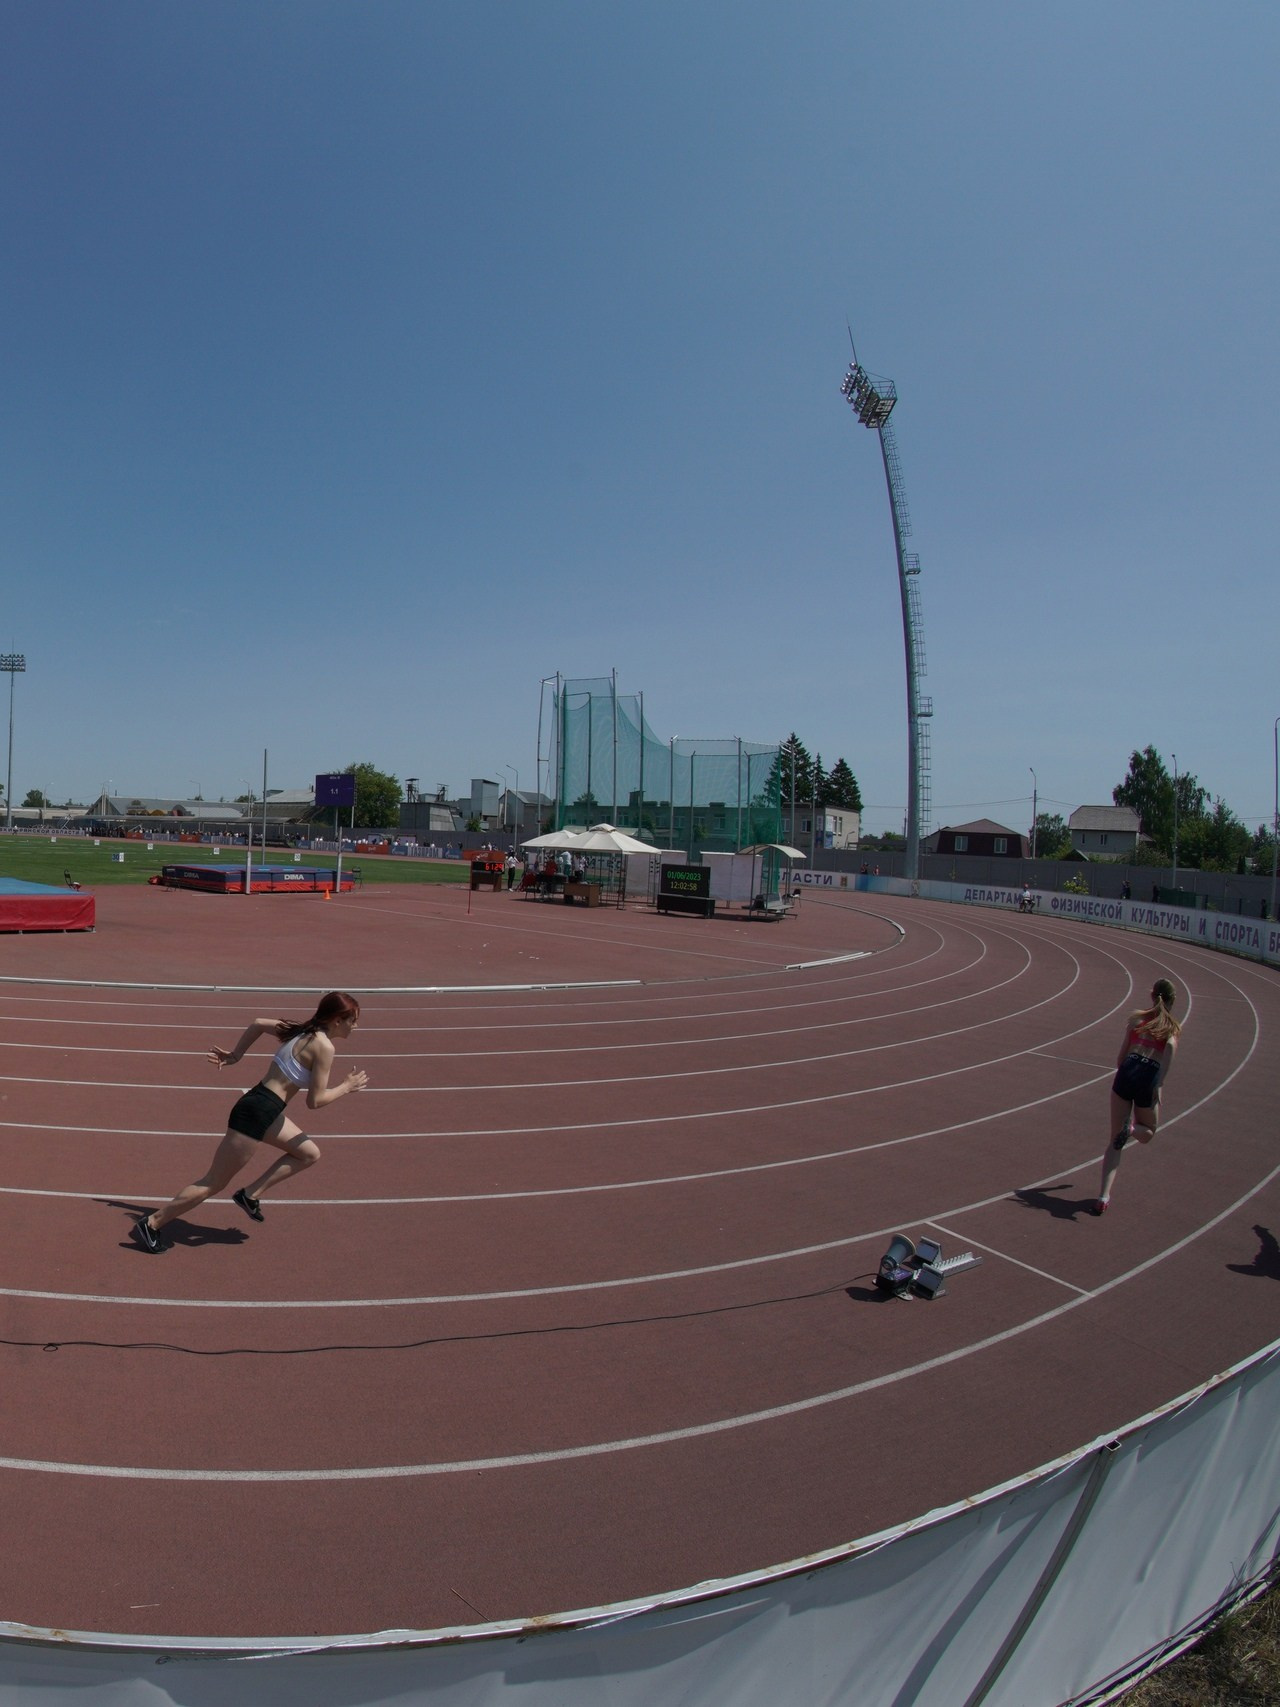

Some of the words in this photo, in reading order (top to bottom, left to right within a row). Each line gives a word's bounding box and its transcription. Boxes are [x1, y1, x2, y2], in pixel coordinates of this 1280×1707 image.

[283, 873, 304, 882] DIMA
[666, 870, 702, 881] 01/06/2023
[670, 881, 698, 891] 12:02:58
[964, 888, 1042, 908] ДЕПАРТАМТ
[1051, 896, 1123, 921] ФИЗИЧЕСКОЙ
[1130, 907, 1190, 933] КУЛЬТУРЫ
[1198, 918, 1207, 936] И
[1215, 920, 1260, 949] СПОРТА
